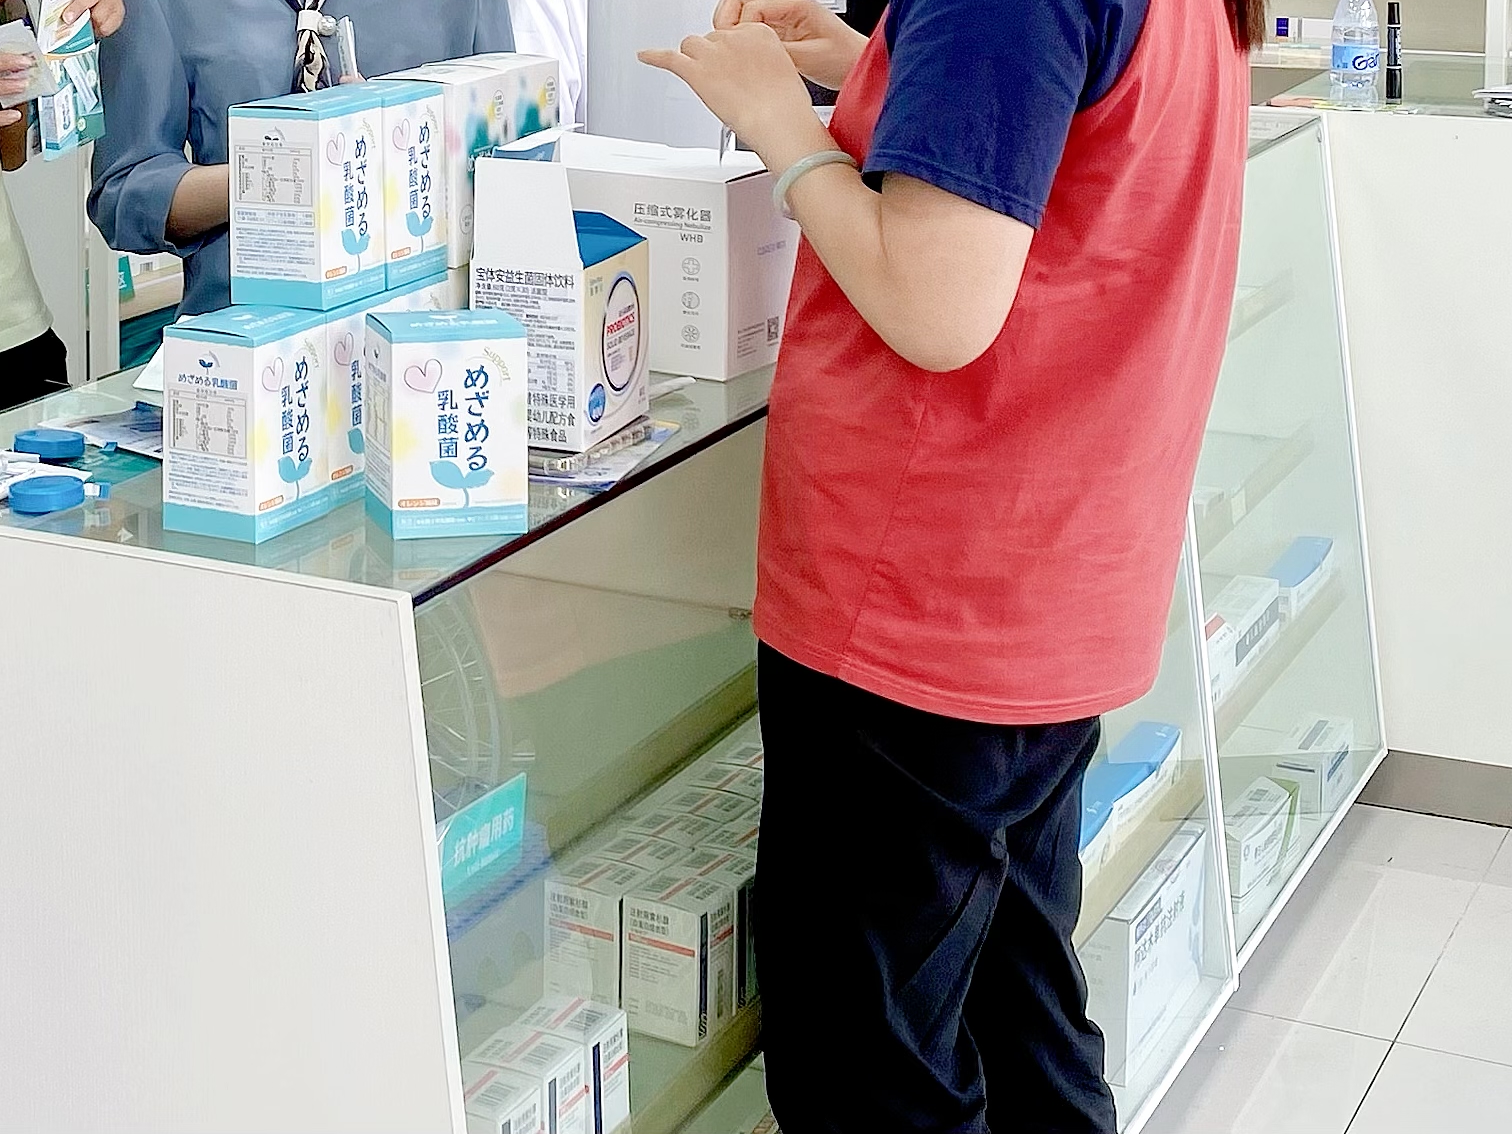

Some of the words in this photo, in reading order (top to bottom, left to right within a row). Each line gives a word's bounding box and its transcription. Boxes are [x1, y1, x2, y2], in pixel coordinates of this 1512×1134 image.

[343, 161, 355, 227] 乳酸菌
[355, 135, 368, 236] めざめる
[408, 146, 419, 210] 乳酸菌
[418, 121, 431, 218] めざめる
[634, 202, 711, 222] 压缩式雾化器
[476, 267, 575, 289] 宝体安益生菌固体饮料
[178, 373, 239, 390] めざめる乳酸菌
[351, 360, 362, 427] 乳酸菌
[482, 345, 512, 382] Support
[281, 384, 294, 455] 乳酸菌
[294, 355, 310, 462] めざめる
[437, 389, 459, 459] 乳酸菌
[464, 365, 490, 471] めざめる
